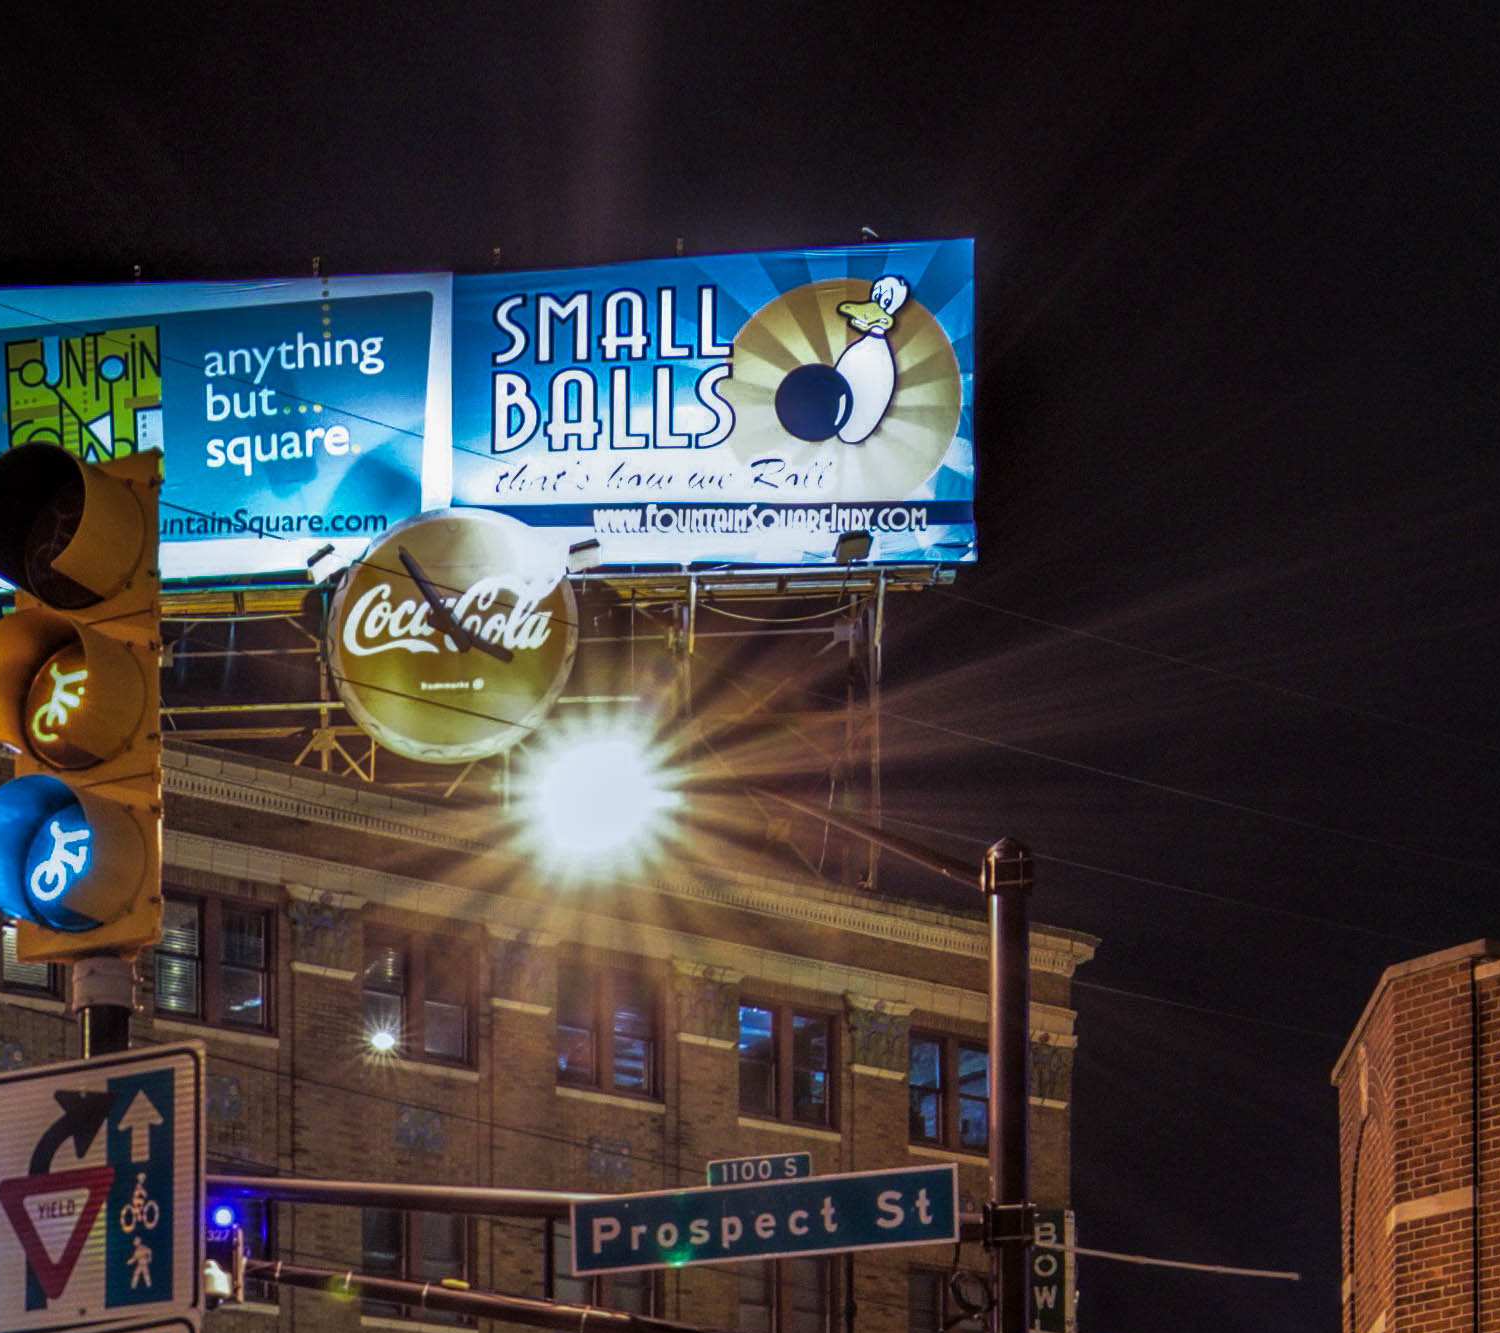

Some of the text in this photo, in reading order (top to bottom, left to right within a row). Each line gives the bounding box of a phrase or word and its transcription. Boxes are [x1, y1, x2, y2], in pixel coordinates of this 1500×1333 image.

[491, 285, 734, 367] SMALL
[204, 332, 385, 384] anything
[491, 364, 736, 454] BALLS
[206, 425, 361, 476] square.
[750, 458, 834, 491] Roll
[160, 510, 388, 539] untainSquare.com
[720, 1156, 799, 1184] 1100 S
[38, 1198, 77, 1220] YIELD
[591, 1187, 934, 1255] Prospect St
